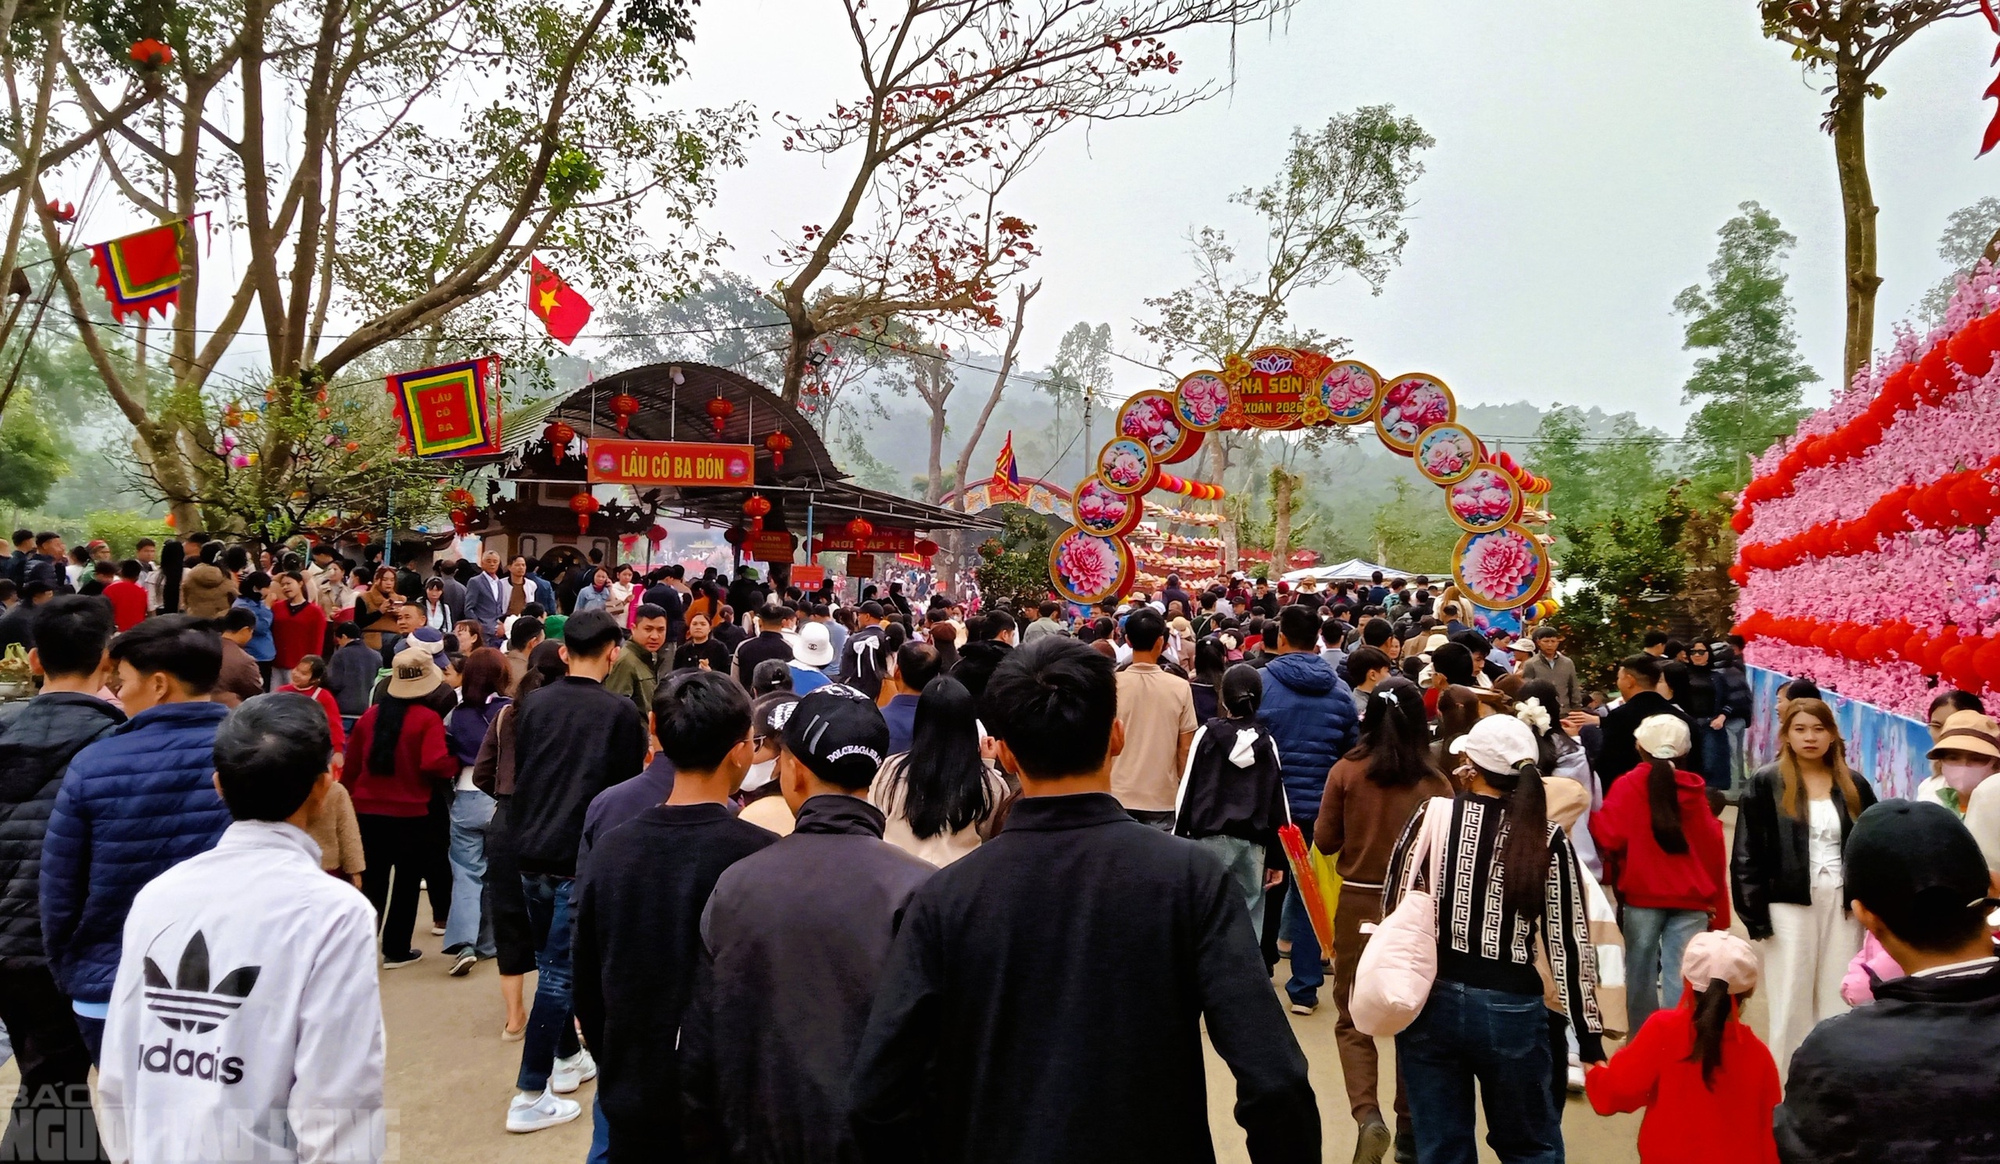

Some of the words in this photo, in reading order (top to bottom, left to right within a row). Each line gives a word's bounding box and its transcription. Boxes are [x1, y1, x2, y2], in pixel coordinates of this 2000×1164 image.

[1241, 378, 1263, 394] NA
[1268, 375, 1302, 394] SƠN
[1244, 400, 1272, 413] XUÂN
[1276, 402, 1304, 413] 2026
[438, 423, 454, 432] BA
[621, 447, 648, 478] LẦU
[652, 452, 670, 479] CÔ
[674, 457, 692, 479] BA
[696, 453, 724, 480] ĐÓN
